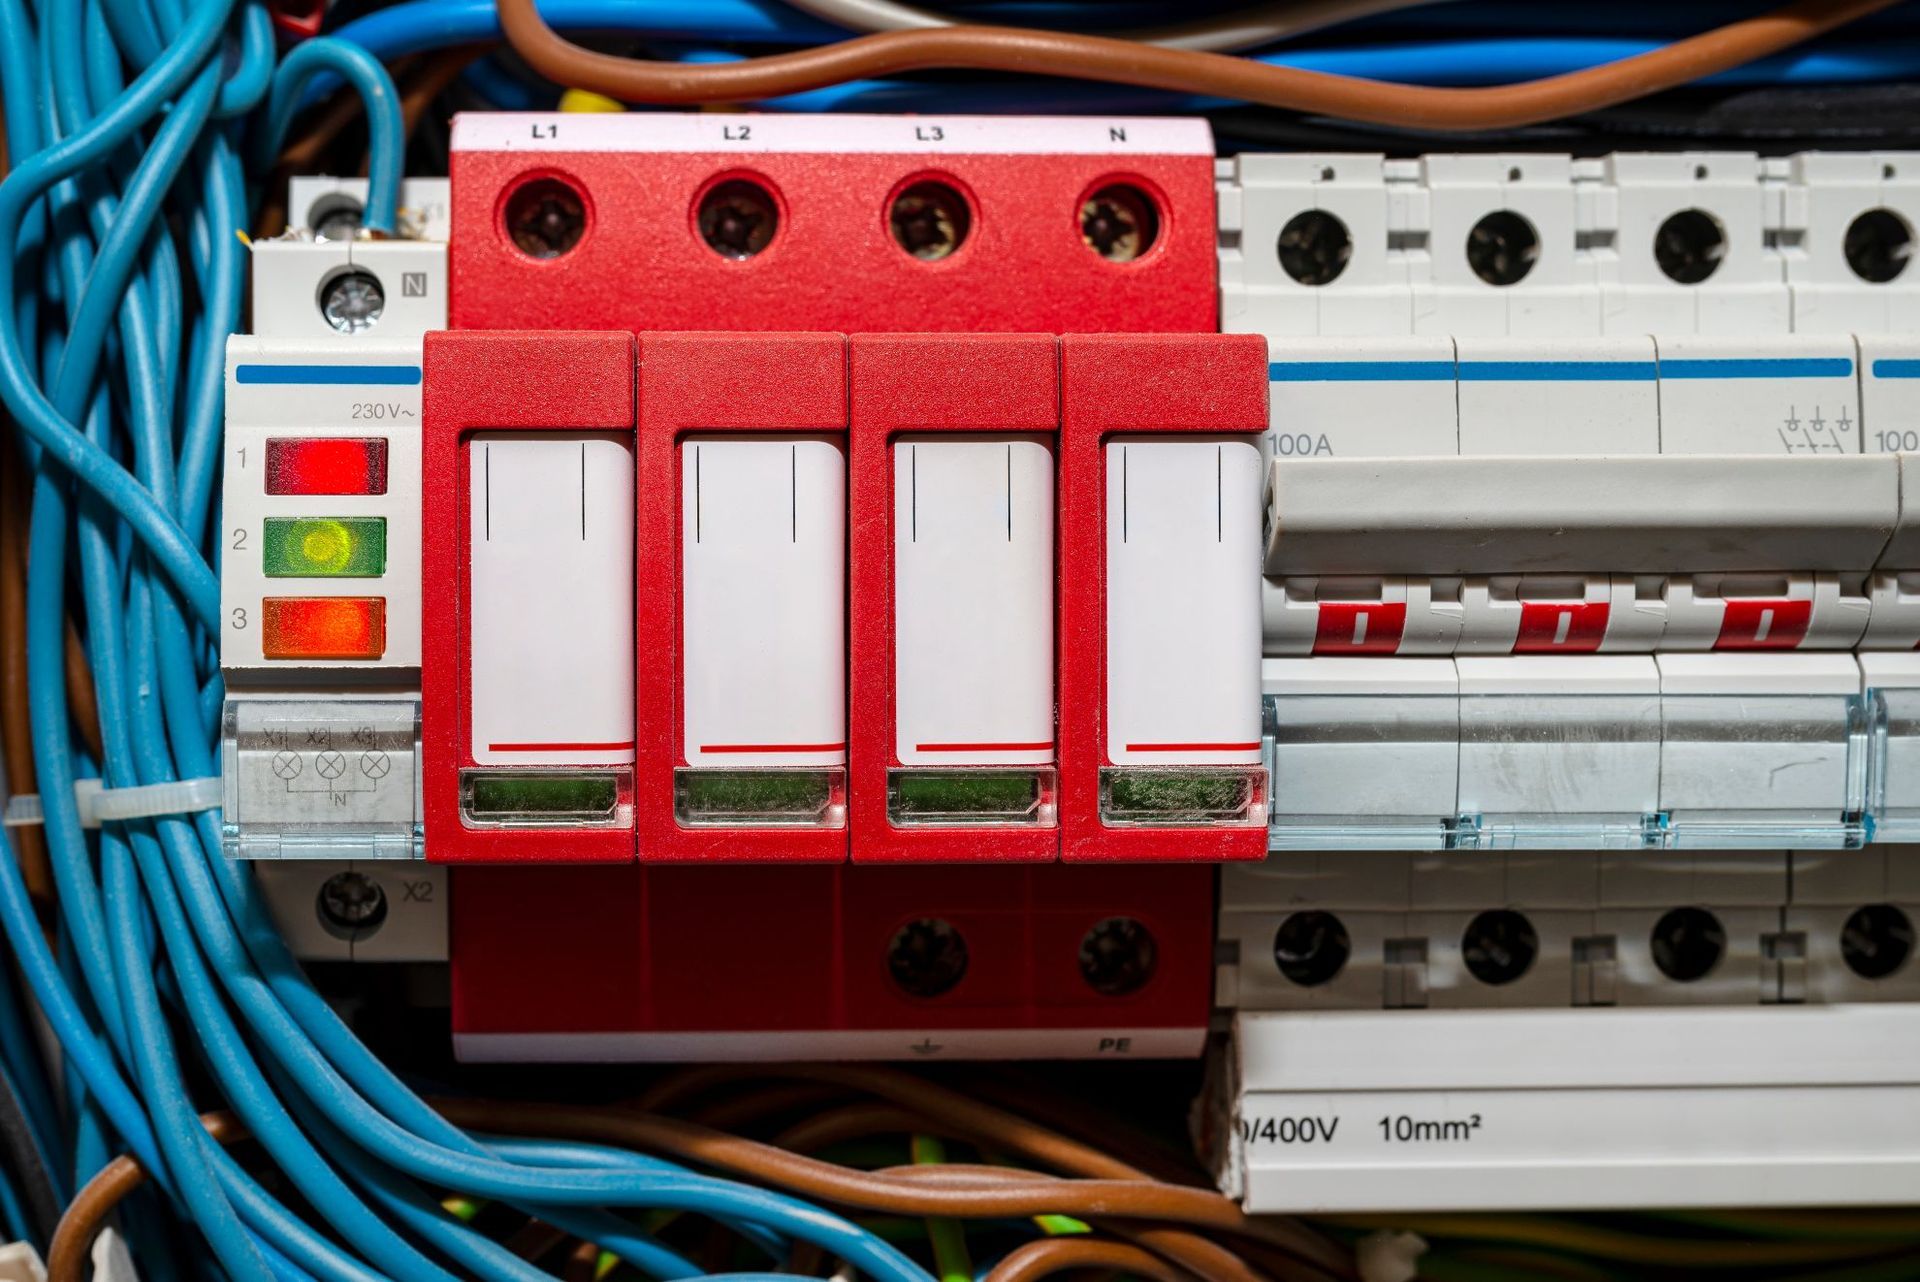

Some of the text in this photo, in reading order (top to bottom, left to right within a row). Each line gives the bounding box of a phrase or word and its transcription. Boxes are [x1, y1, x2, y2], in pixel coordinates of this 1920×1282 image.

[531, 124, 1127, 143] L1 L2 L3 N
[405, 274, 424, 295] N
[1268, 433, 1333, 456] 100A
[237, 448, 247, 469] 1
[232, 528, 248, 551] 2
[231, 607, 248, 630] 3
[334, 792, 347, 806] N
[403, 881, 433, 902] X2
[1099, 1038, 1131, 1053] PE
[1378, 1113, 1483, 1142] 10mm²
